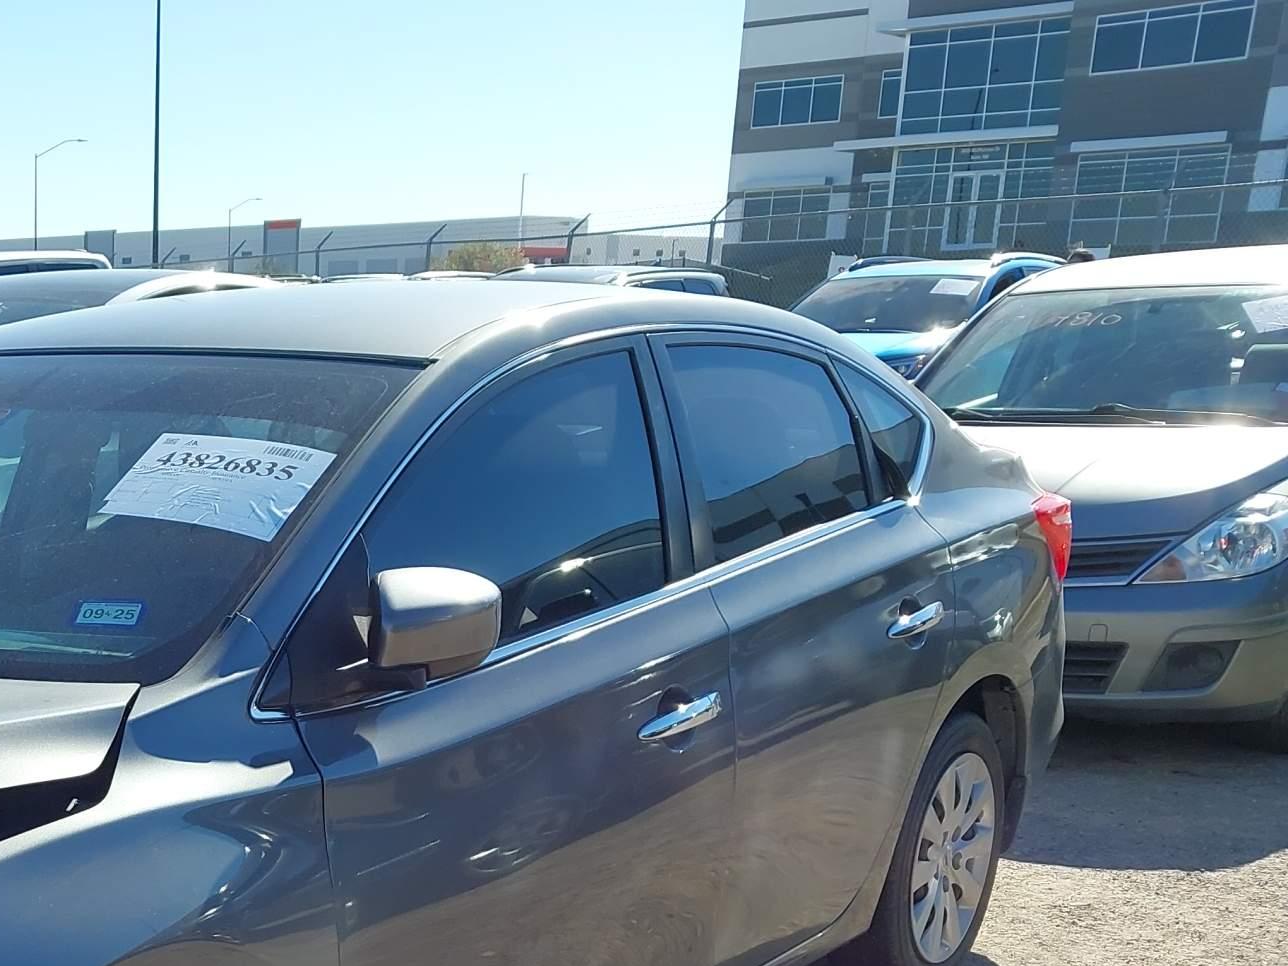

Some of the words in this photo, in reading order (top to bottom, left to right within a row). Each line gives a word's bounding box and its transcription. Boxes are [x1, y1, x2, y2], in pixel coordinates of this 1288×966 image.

[156, 450, 299, 481] 43826835
[82, 608, 105, 619] 09
[112, 608, 137, 620] 25
